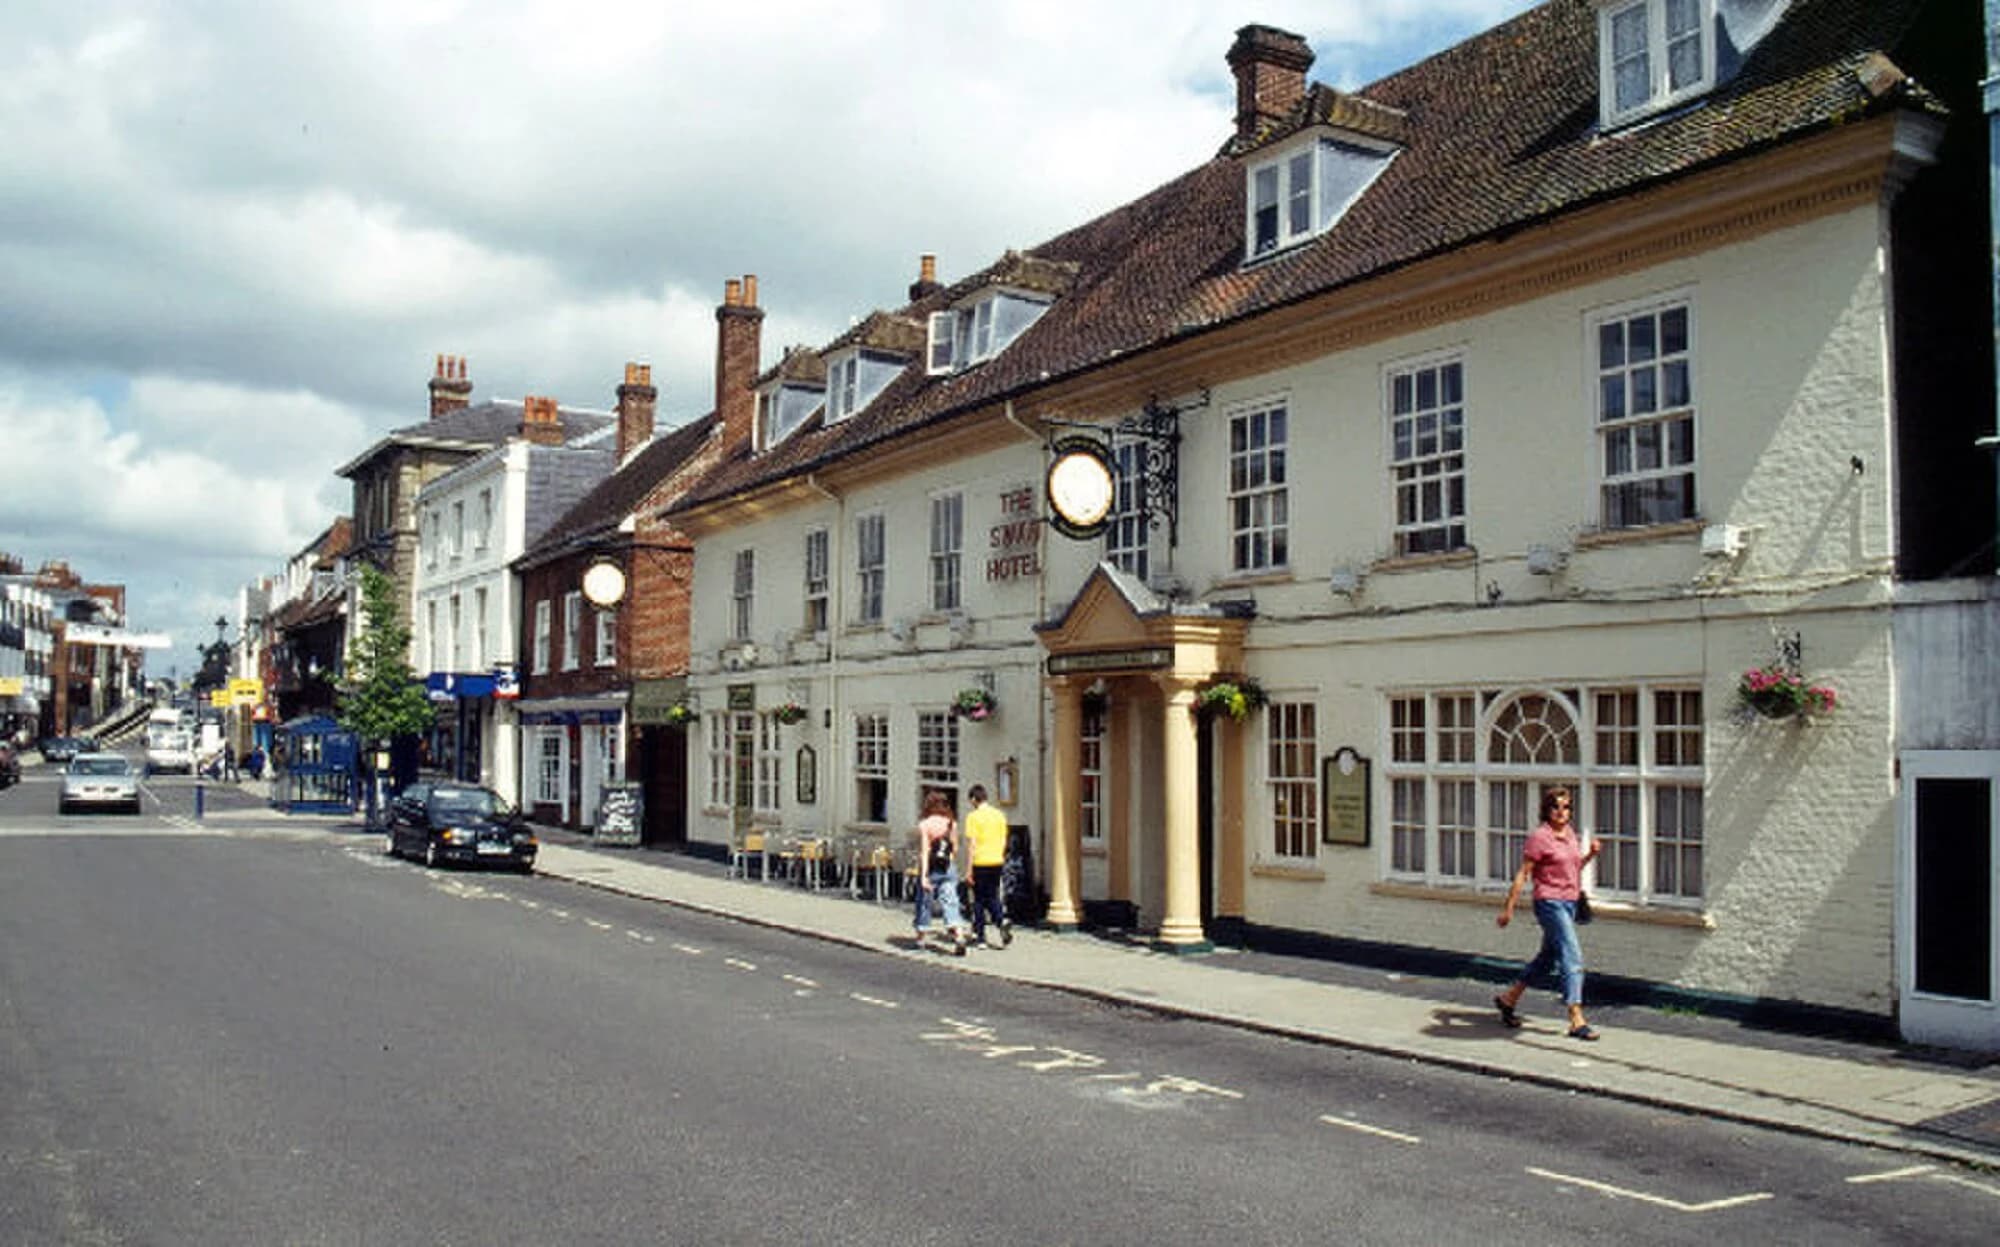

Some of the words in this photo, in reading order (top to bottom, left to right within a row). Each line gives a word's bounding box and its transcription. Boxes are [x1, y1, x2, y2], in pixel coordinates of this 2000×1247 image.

[1000, 487, 1032, 514] THE
[990, 521, 1040, 548] SWAN
[986, 553, 1041, 583] HOTEL
